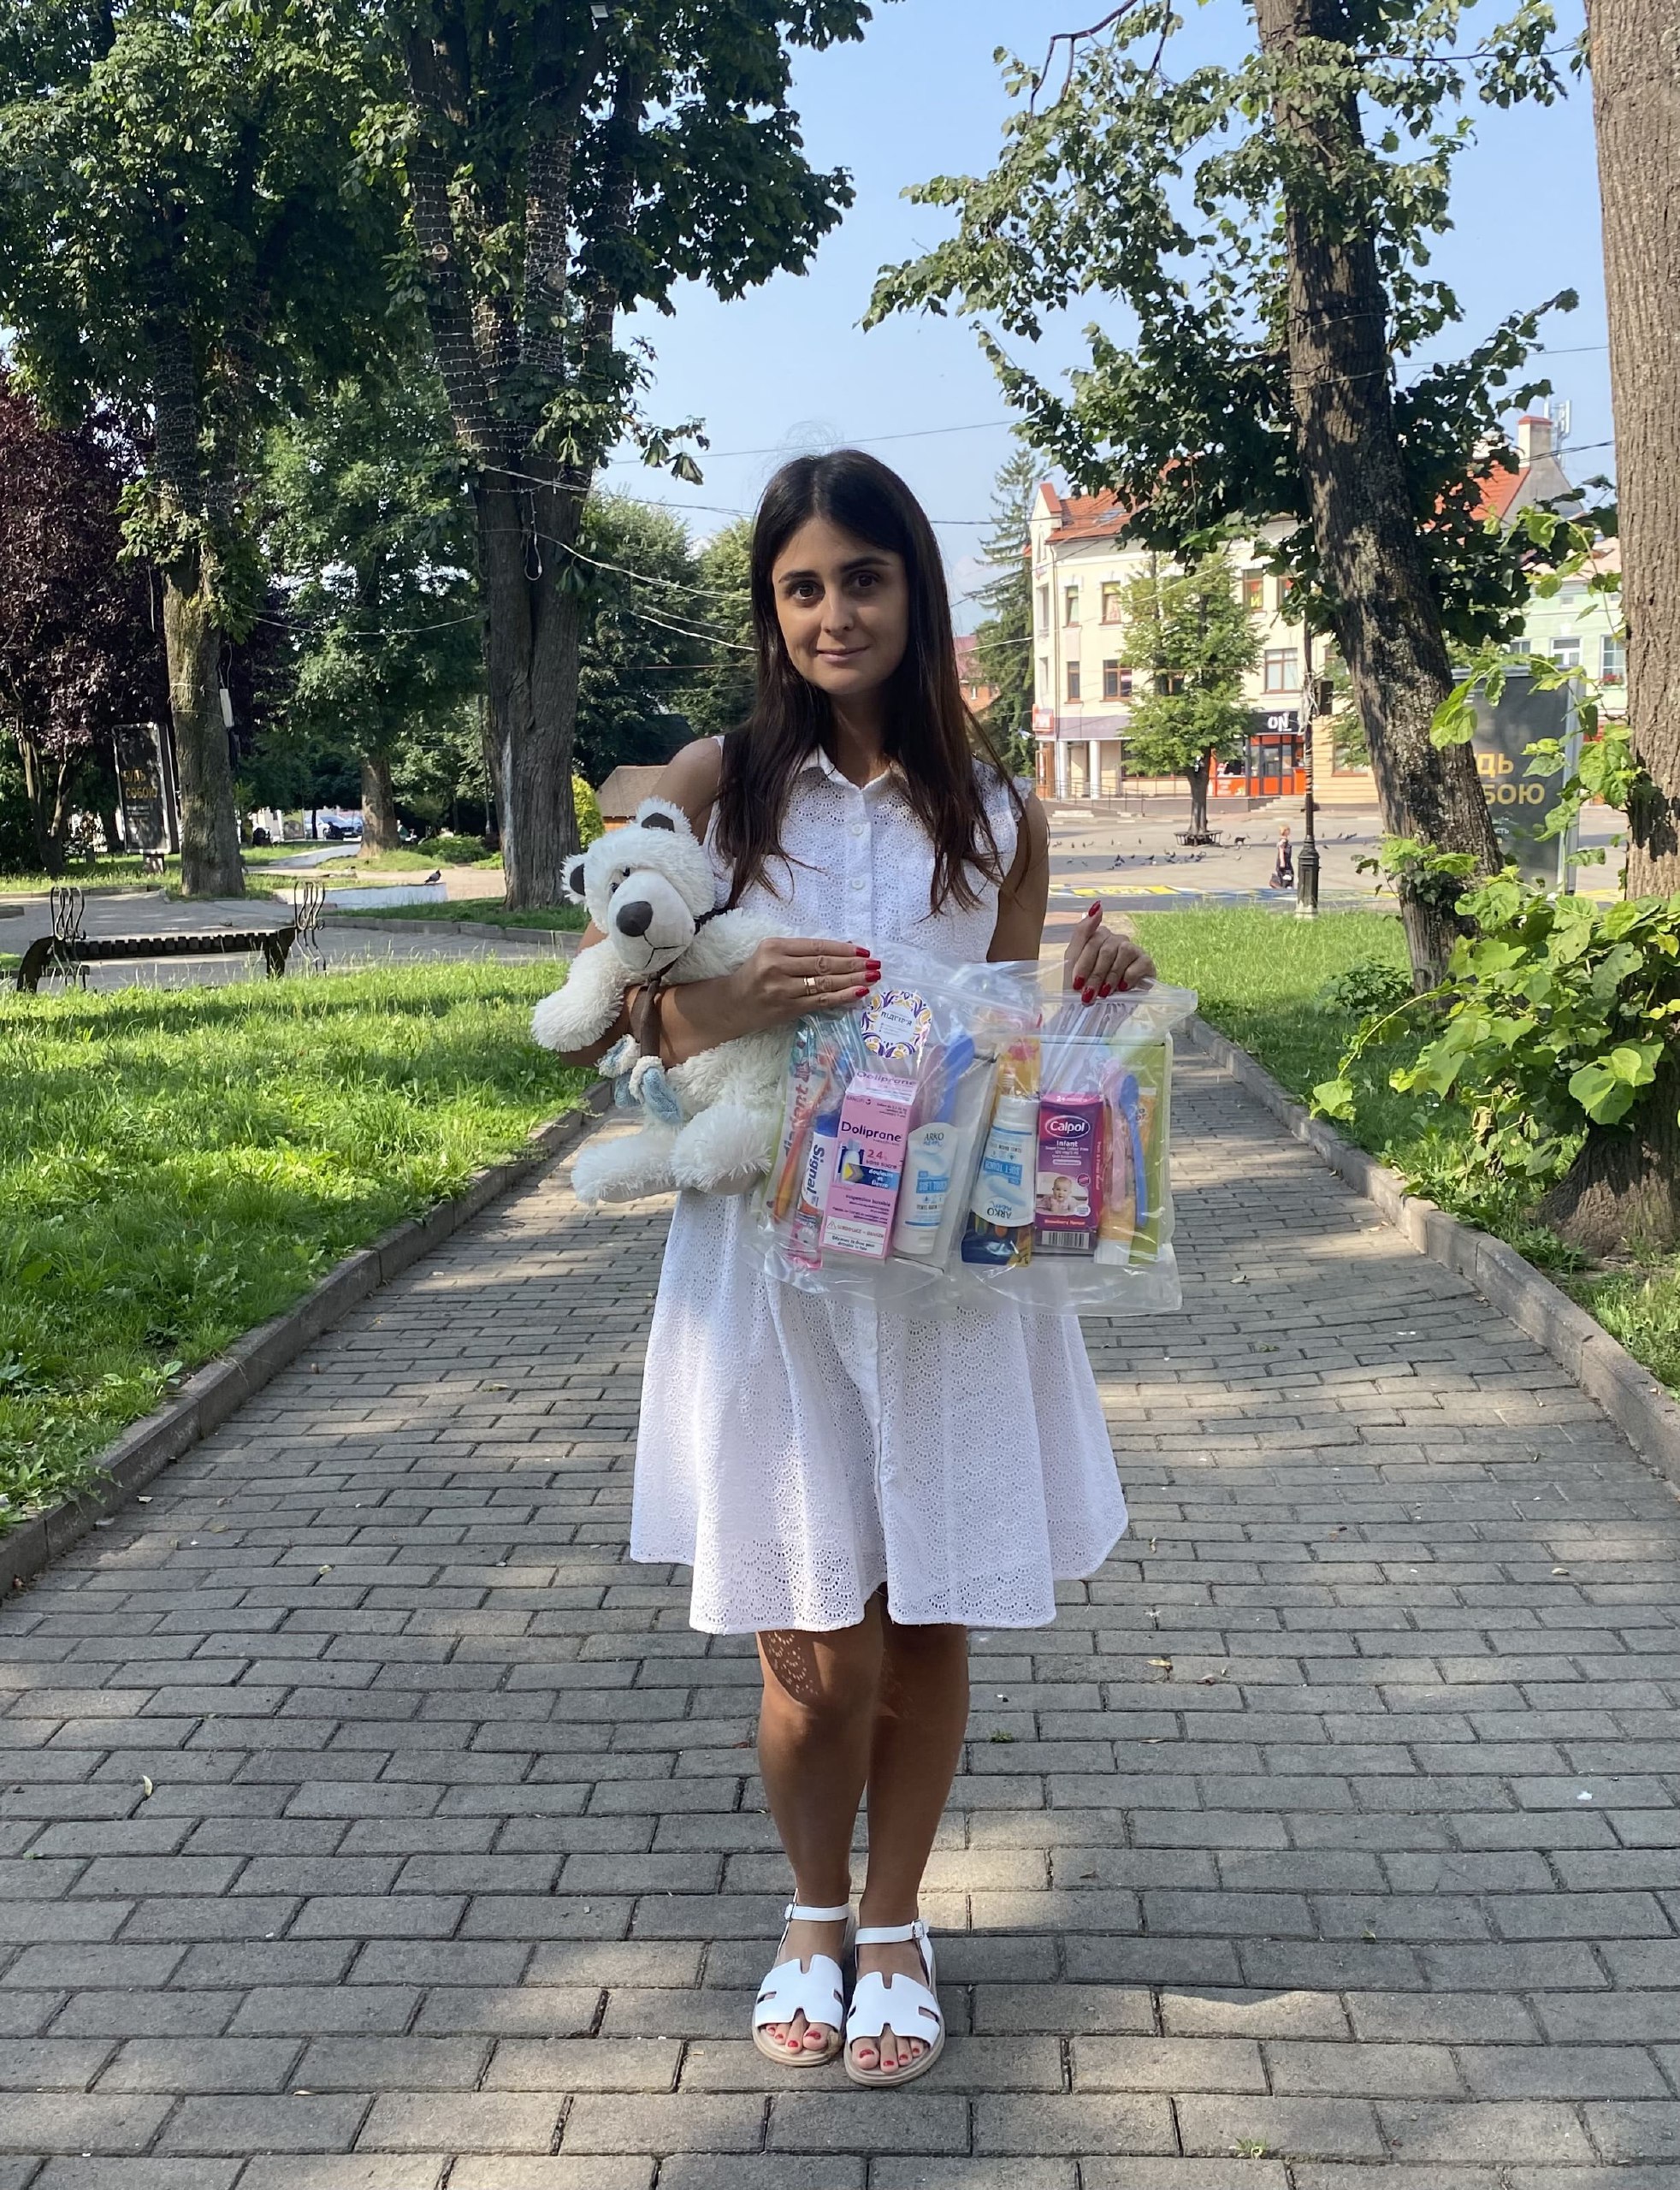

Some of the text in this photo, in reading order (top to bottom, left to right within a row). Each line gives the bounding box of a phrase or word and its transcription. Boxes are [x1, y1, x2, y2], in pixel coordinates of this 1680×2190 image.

[1474, 753, 1514, 778] ДЬ
[1482, 783, 1545, 805] БОЮ
[856, 1071, 917, 1086] Doliprane
[841, 1121, 902, 1143] Doliprane
[924, 1132, 944, 1141] ARKO
[1050, 1121, 1085, 1134] Calpol
[806, 1144, 825, 1194] Signal
[986, 1207, 1013, 1219] ARKO
